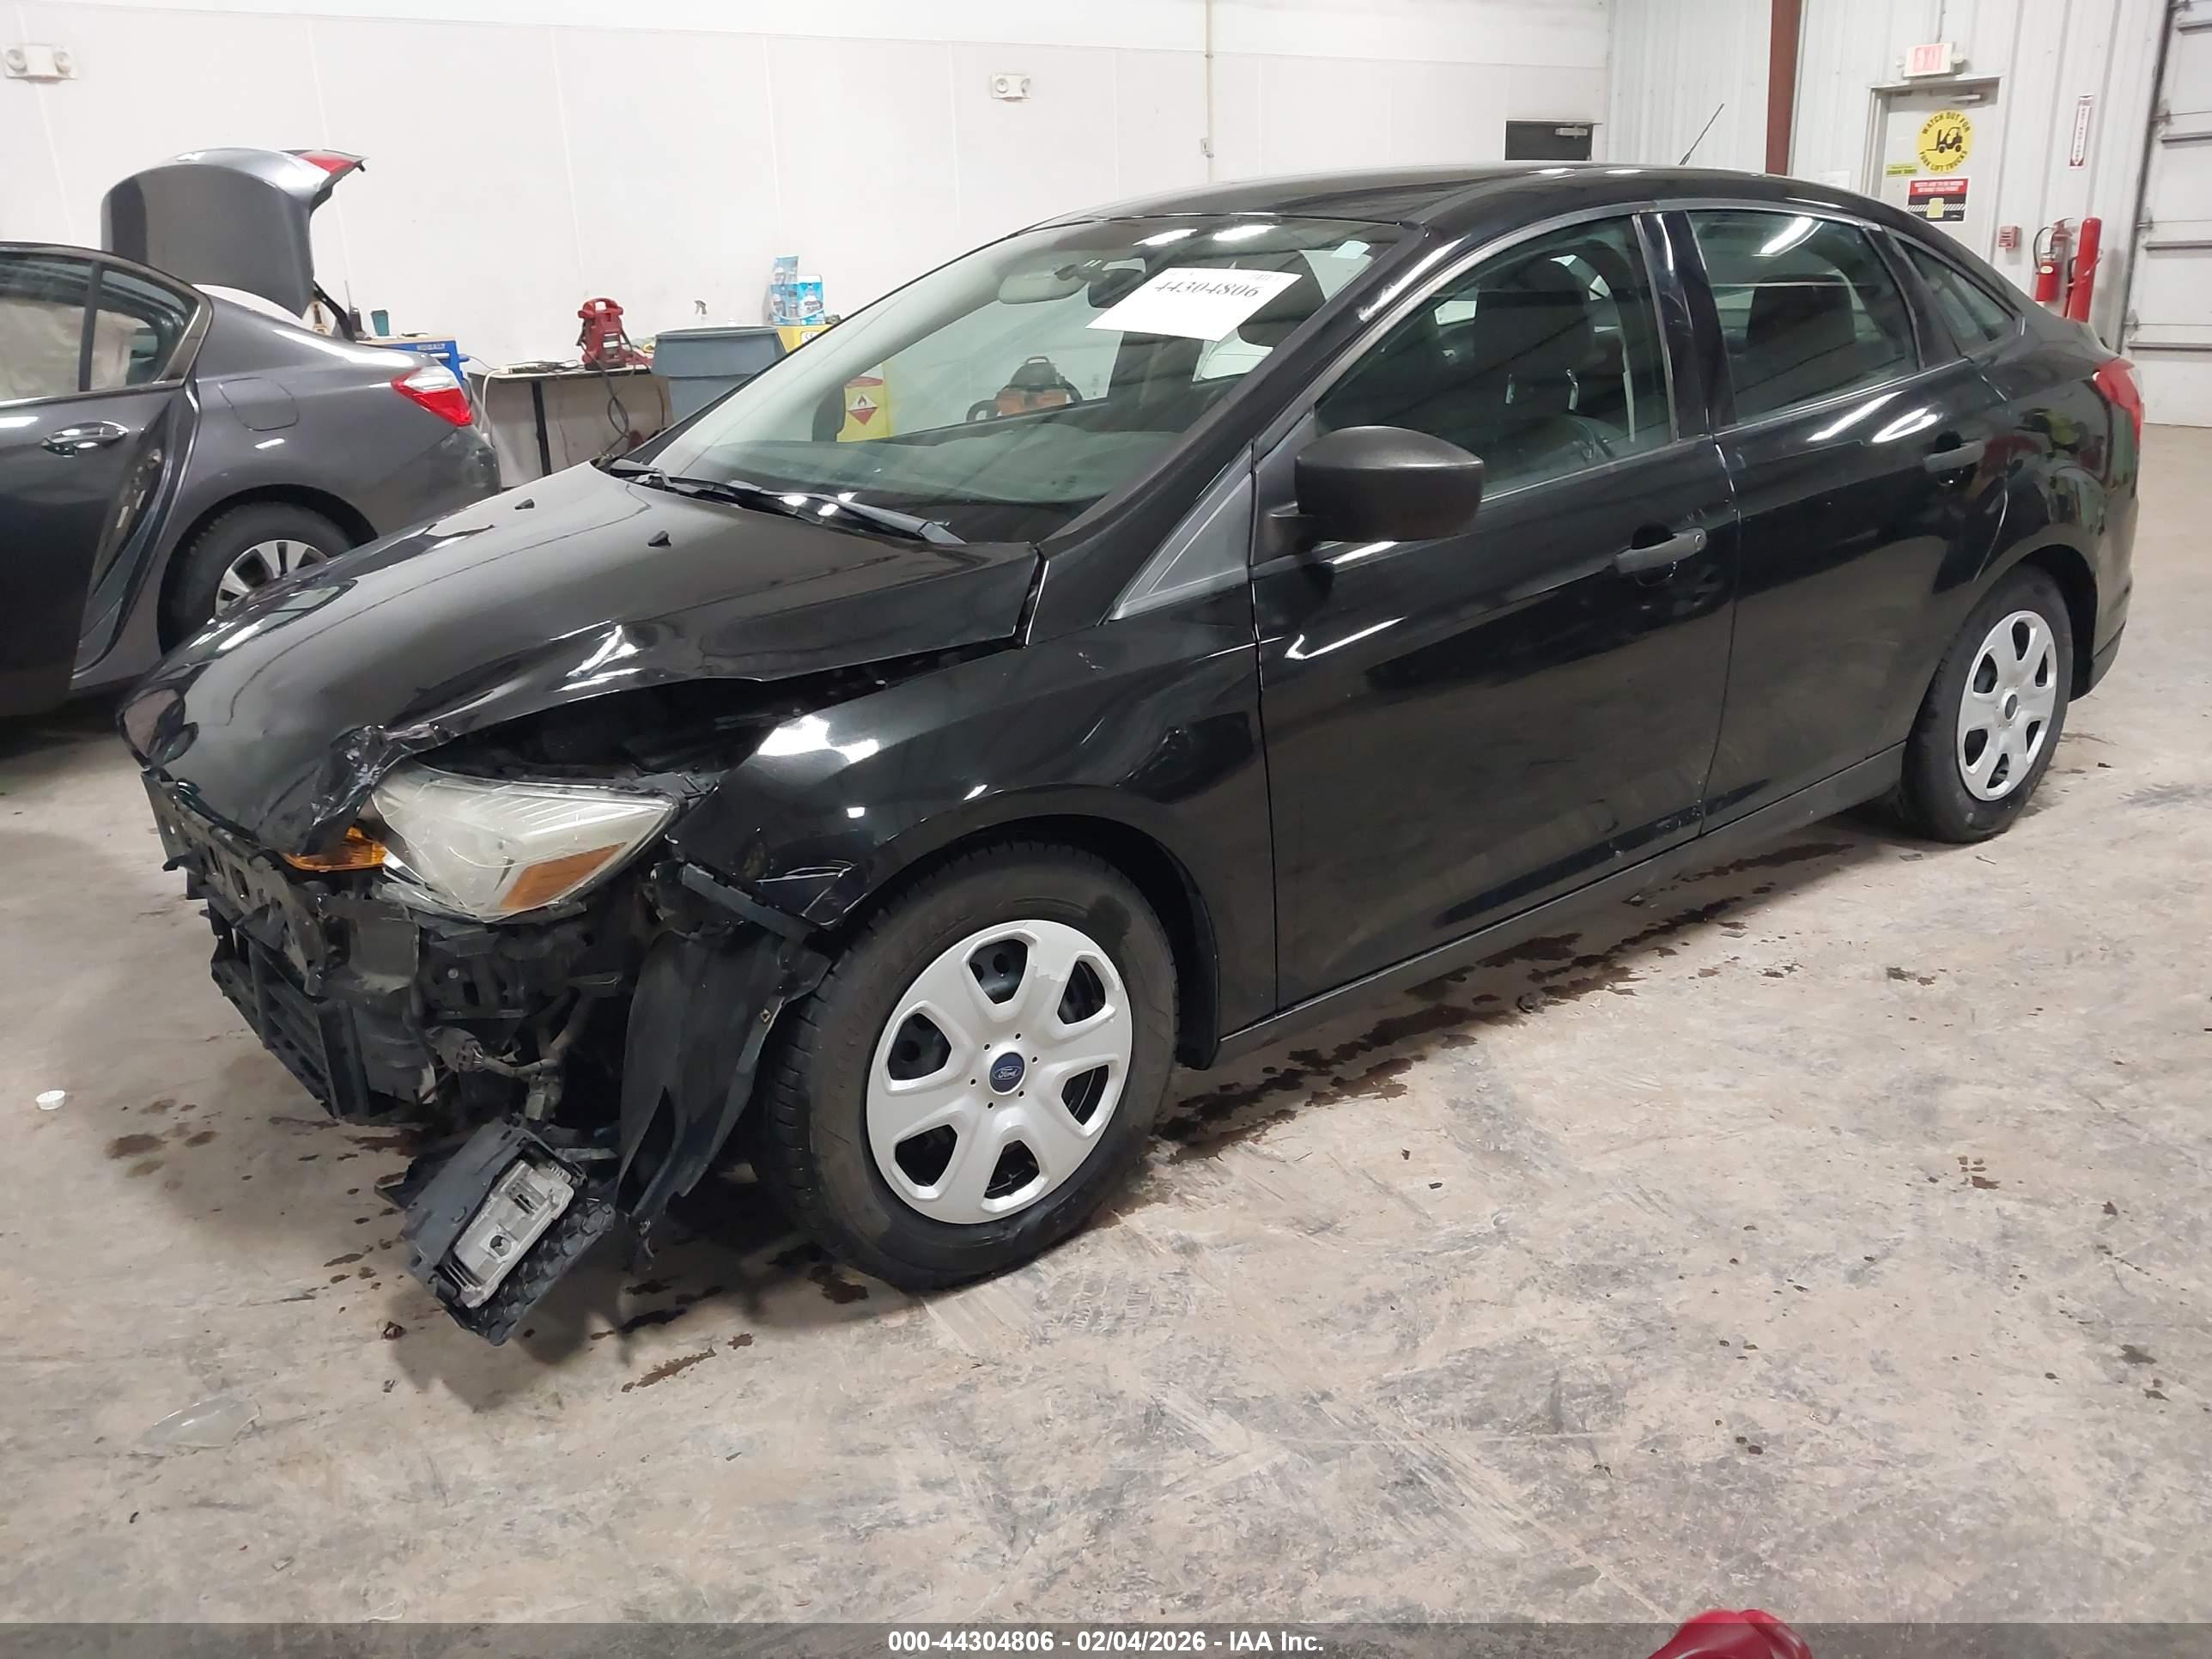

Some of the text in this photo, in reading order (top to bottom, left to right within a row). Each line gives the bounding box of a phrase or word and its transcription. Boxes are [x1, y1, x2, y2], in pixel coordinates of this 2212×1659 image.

[1913, 45, 1944, 72] EXIT
[1922, 112, 1972, 135] WATCH OUT FOR
[1919, 151, 1932, 167] FORK
[1154, 281, 1264, 298] 44304806
[998, 1068, 1018, 1079] Ford
